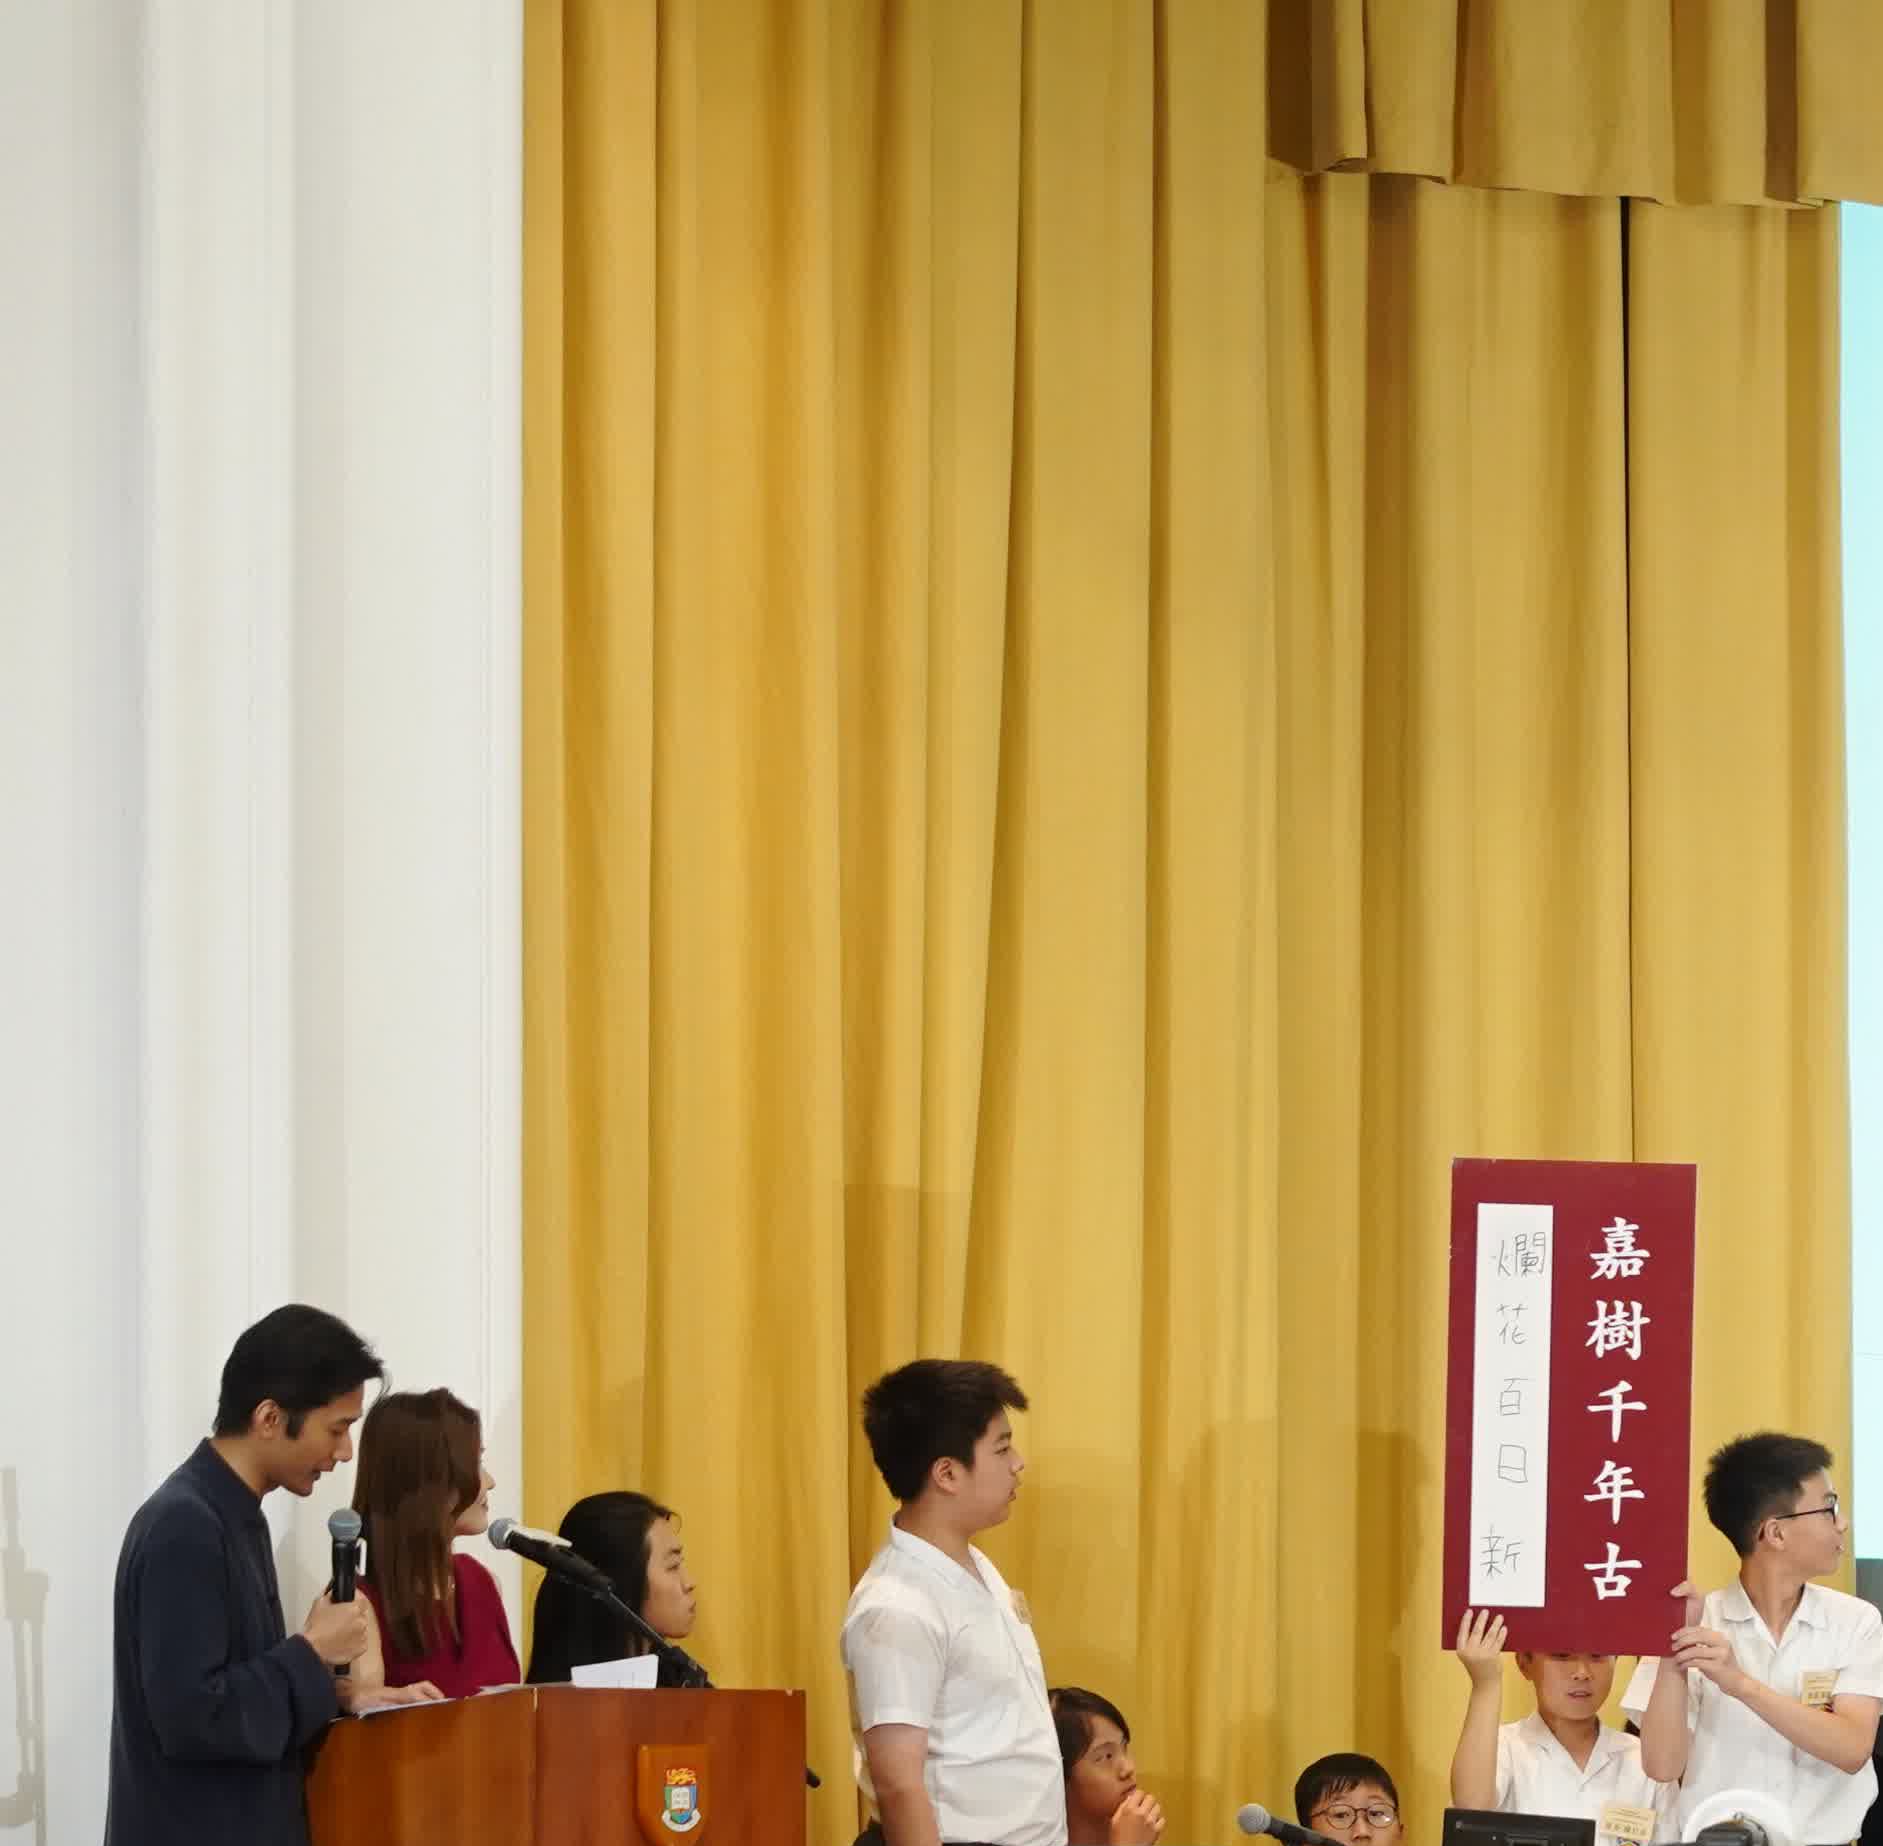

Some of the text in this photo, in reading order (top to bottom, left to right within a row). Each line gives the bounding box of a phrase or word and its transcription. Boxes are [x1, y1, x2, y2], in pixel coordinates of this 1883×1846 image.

[1583, 1216, 1651, 1601] 嘉樹千年古
